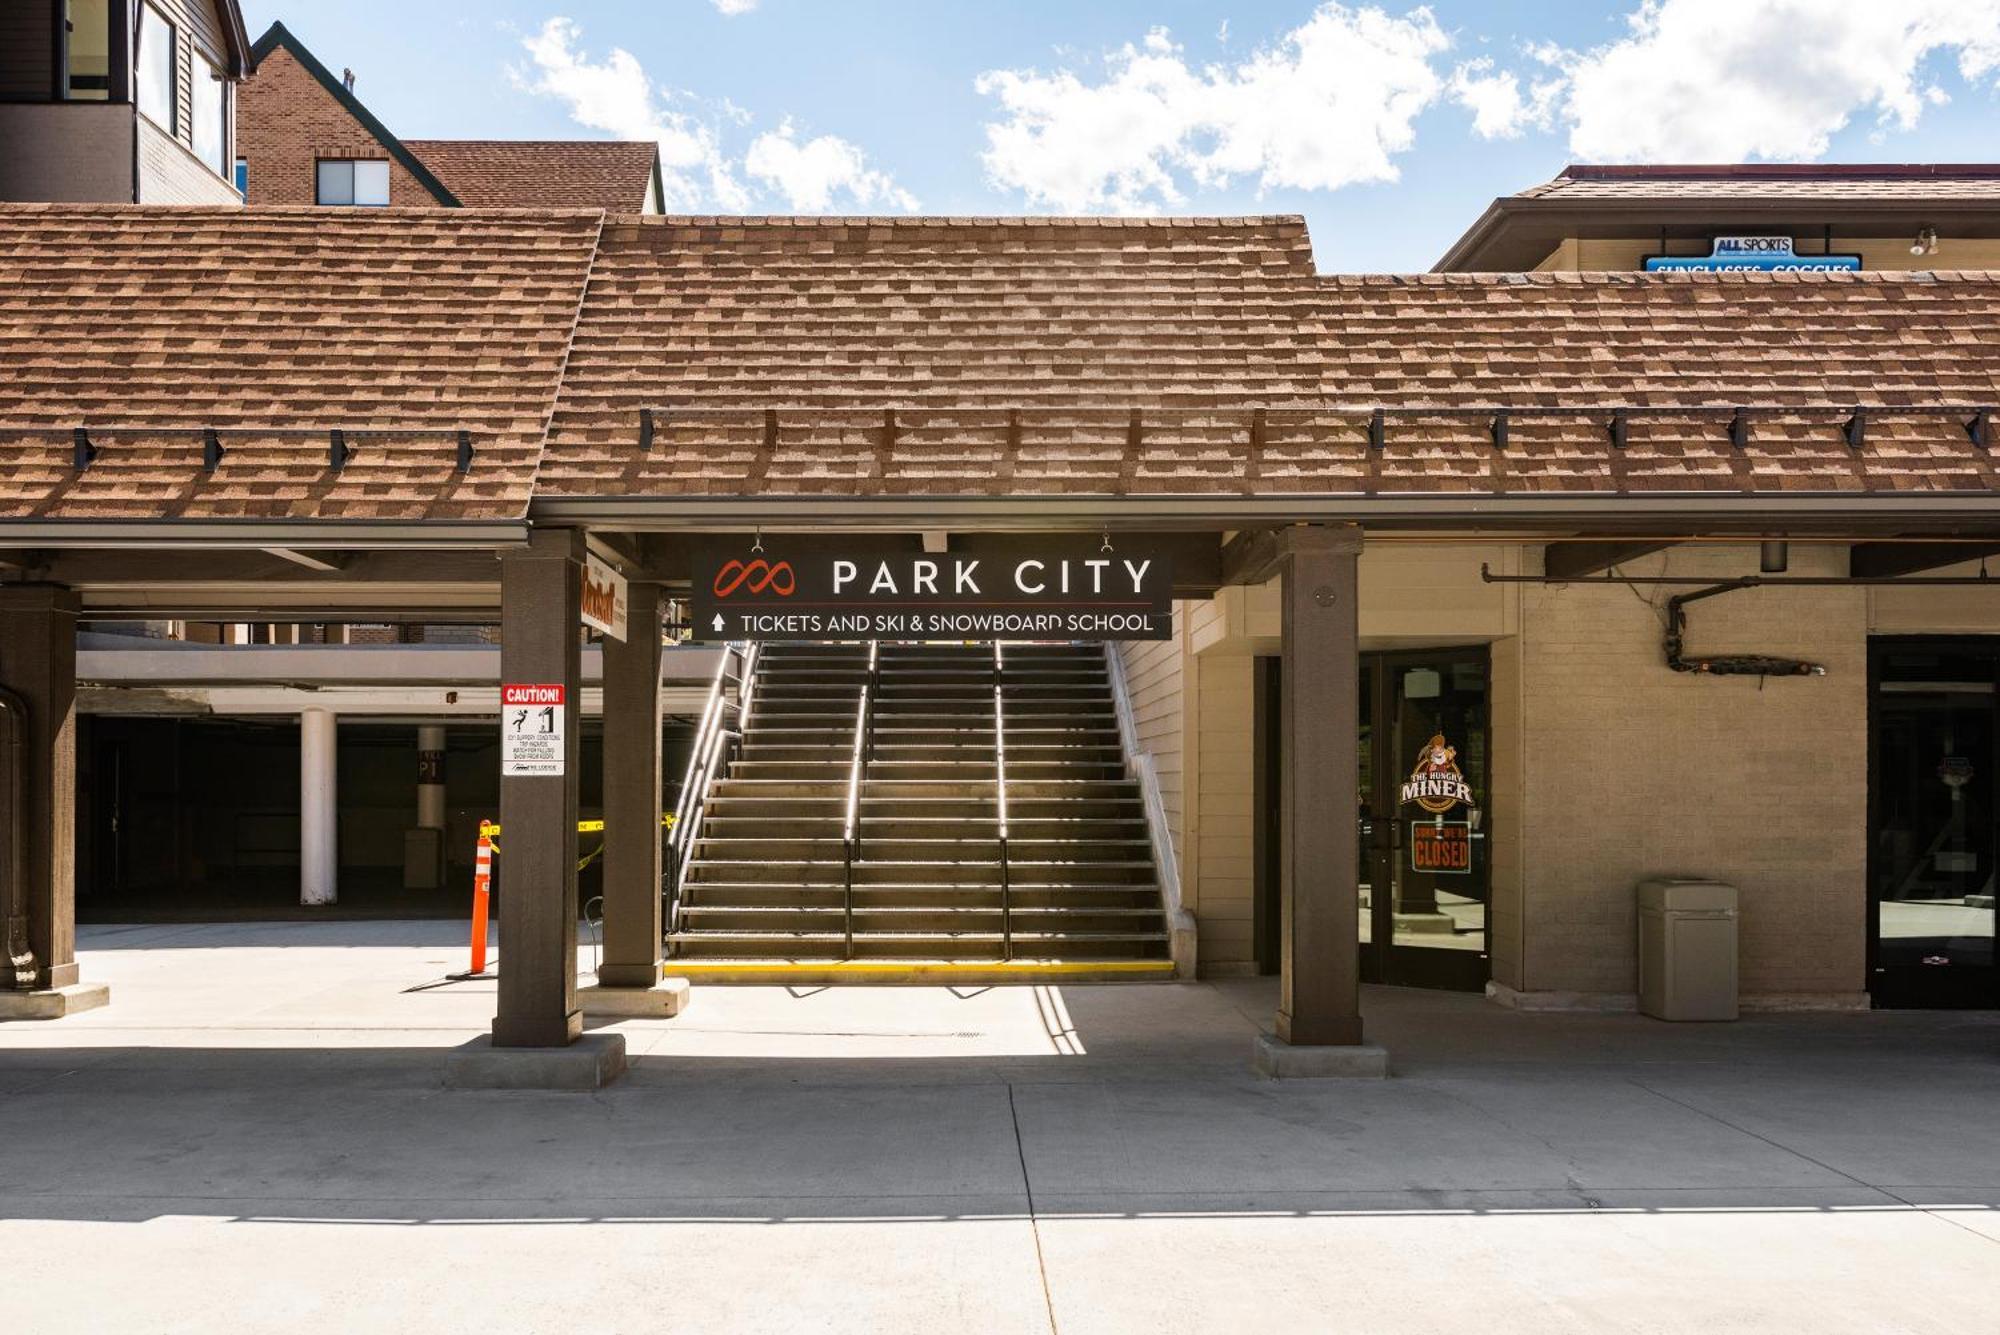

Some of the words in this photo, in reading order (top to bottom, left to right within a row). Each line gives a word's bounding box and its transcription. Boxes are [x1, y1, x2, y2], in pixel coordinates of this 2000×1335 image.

[1716, 239, 1742, 251] ALL
[1743, 238, 1791, 251] SPORTS
[832, 559, 982, 595] PARK
[1014, 559, 1153, 595] CITY
[740, 615, 822, 632] TICKETS
[827, 615, 870, 632] AND
[875, 615, 904, 632] SKI
[909, 615, 924, 632] &
[929, 614, 1062, 632] SNOWBOARD
[1066, 614, 1154, 632] SCHOOL
[506, 687, 560, 703] CAUTION!
[1411, 773, 1428, 783] THE
[1430, 771, 1464, 783] HUNGRY
[1401, 780, 1473, 803] MINER
[1415, 840, 1468, 867] CLOSED
